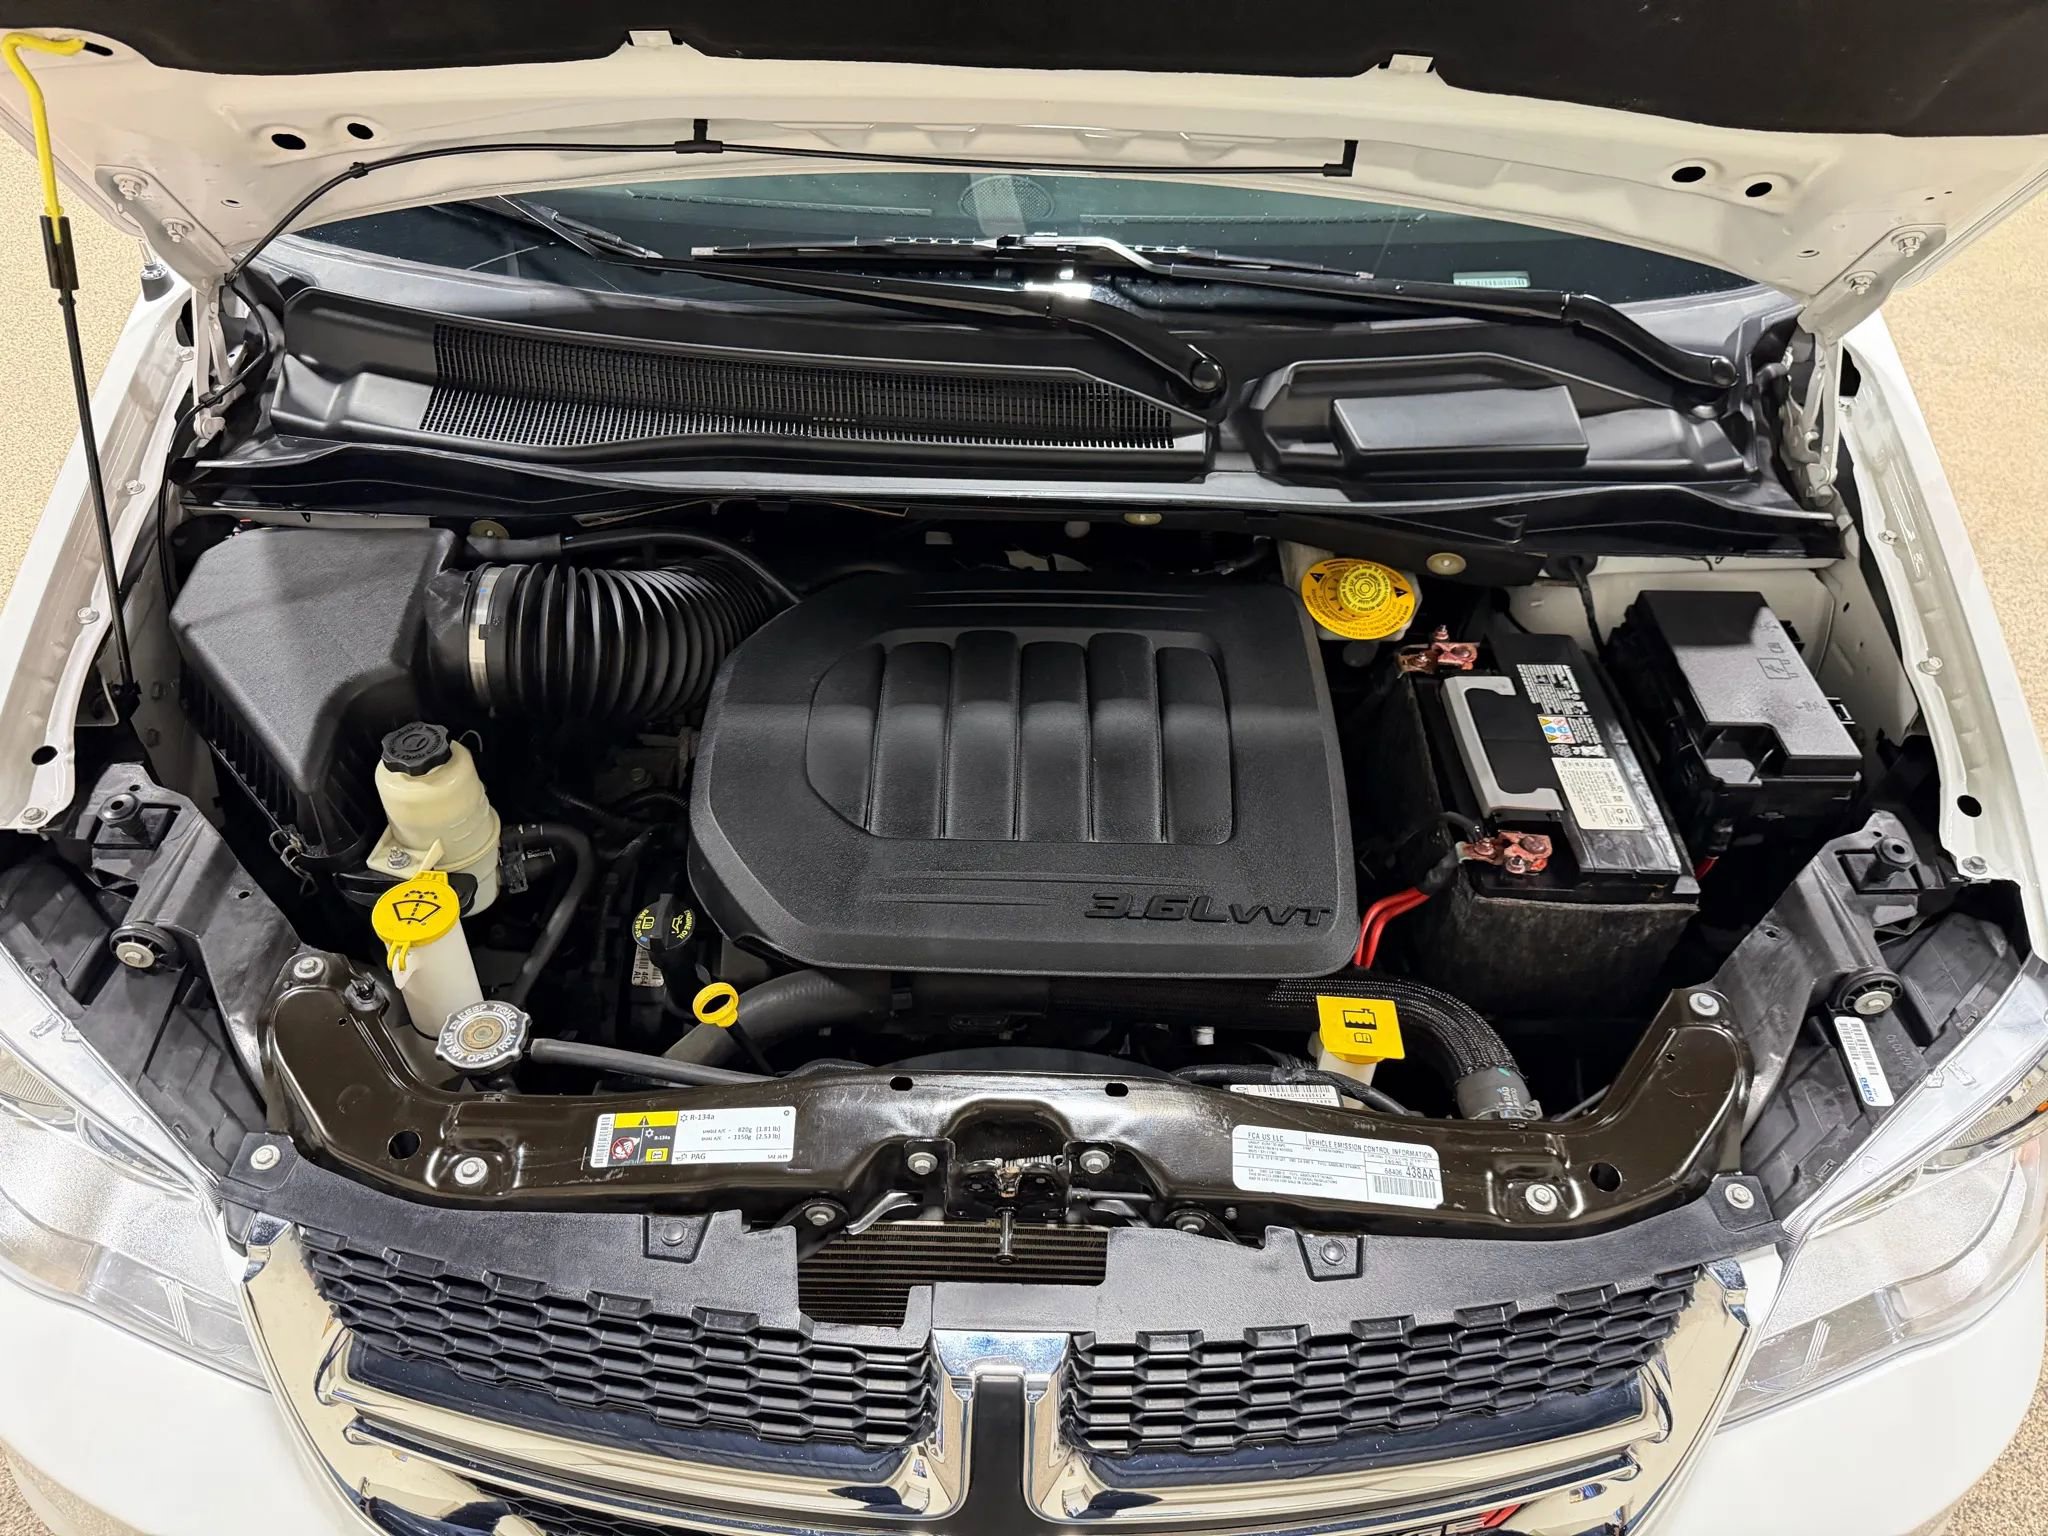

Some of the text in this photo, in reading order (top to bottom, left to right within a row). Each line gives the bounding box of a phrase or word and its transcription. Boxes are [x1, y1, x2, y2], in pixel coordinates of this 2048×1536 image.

[676, 910, 693, 939] ENGINE OIL
[466, 1049, 499, 1062] OPEN
[498, 1033, 517, 1052] HOT
[1859, 1077, 1875, 1102] DEPO
[690, 1113, 715, 1121] R-134a
[1248, 1132, 1260, 1140] FCA
[1308, 1138, 1332, 1148] VEHICLE
[1334, 1140, 1362, 1151] EMISSION
[1363, 1145, 1390, 1155] CONTROL
[1391, 1148, 1432, 1158] INFORMATION
[1406, 1166, 1435, 1180] 438AA
